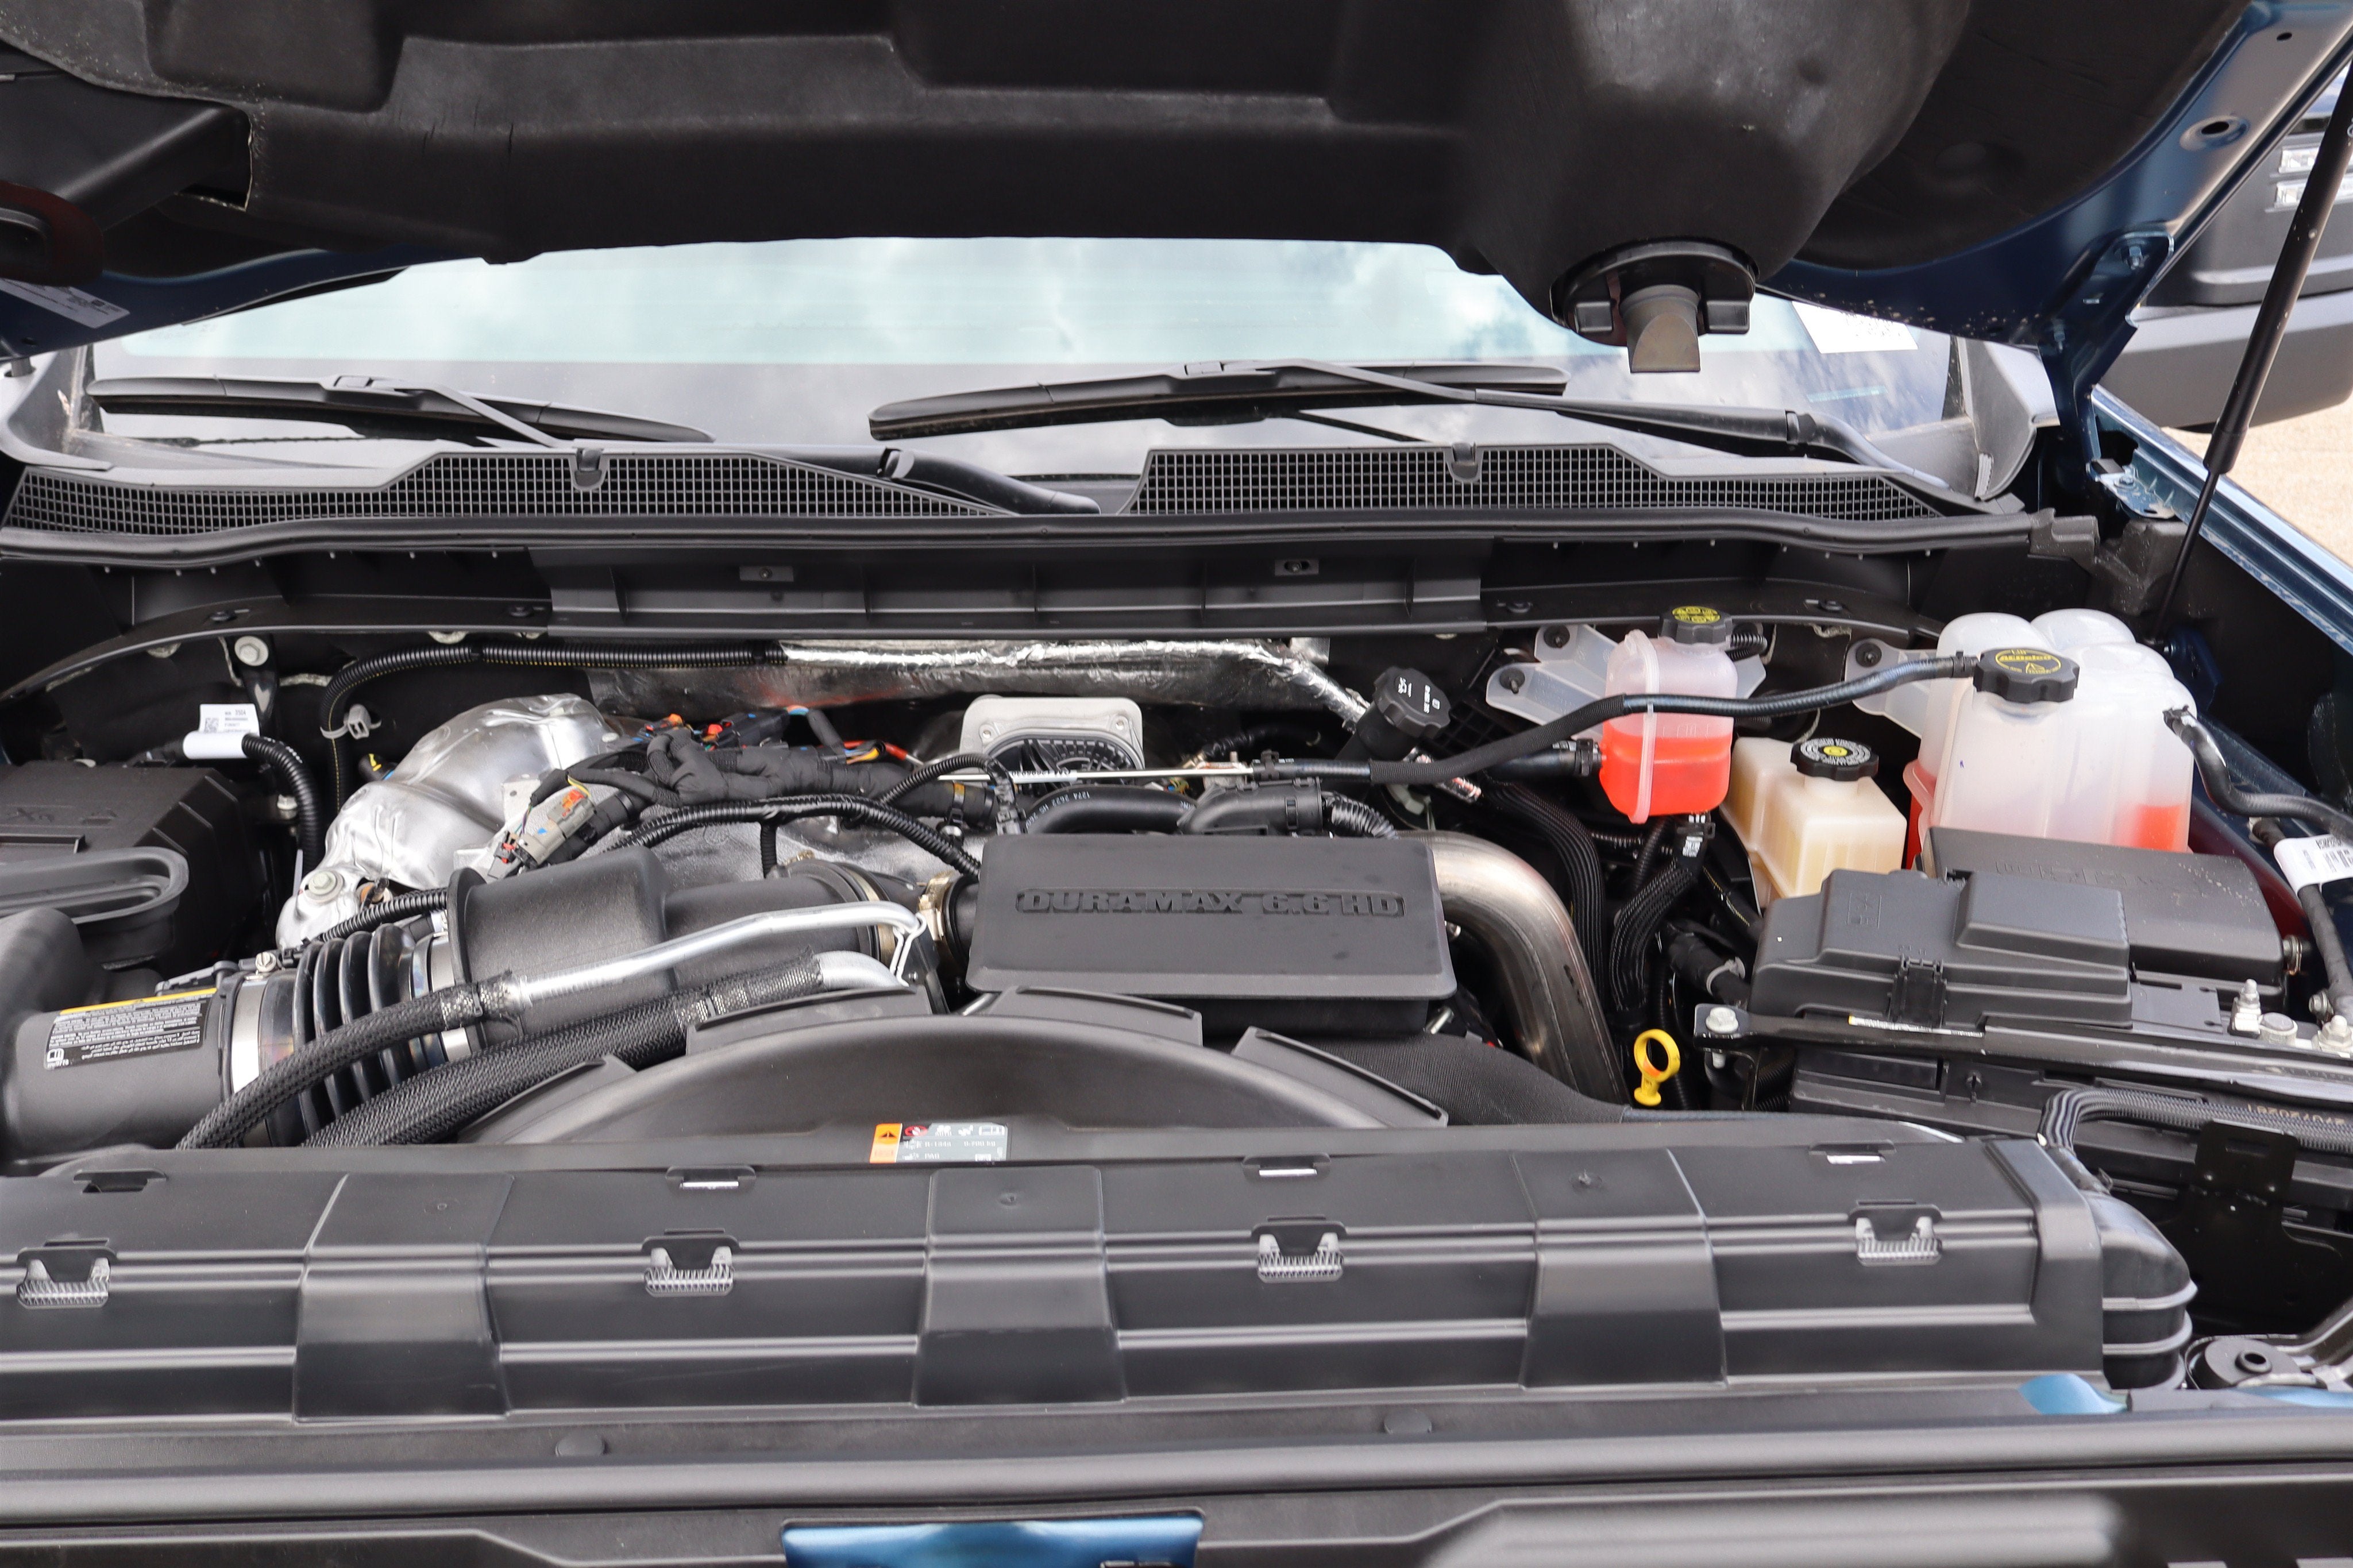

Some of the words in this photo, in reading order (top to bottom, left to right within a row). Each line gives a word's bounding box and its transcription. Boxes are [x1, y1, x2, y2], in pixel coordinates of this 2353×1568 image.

[1022, 891, 1243, 914] DURAMAX
[1263, 893, 1331, 916] 6.6
[1341, 894, 1400, 917] HD
